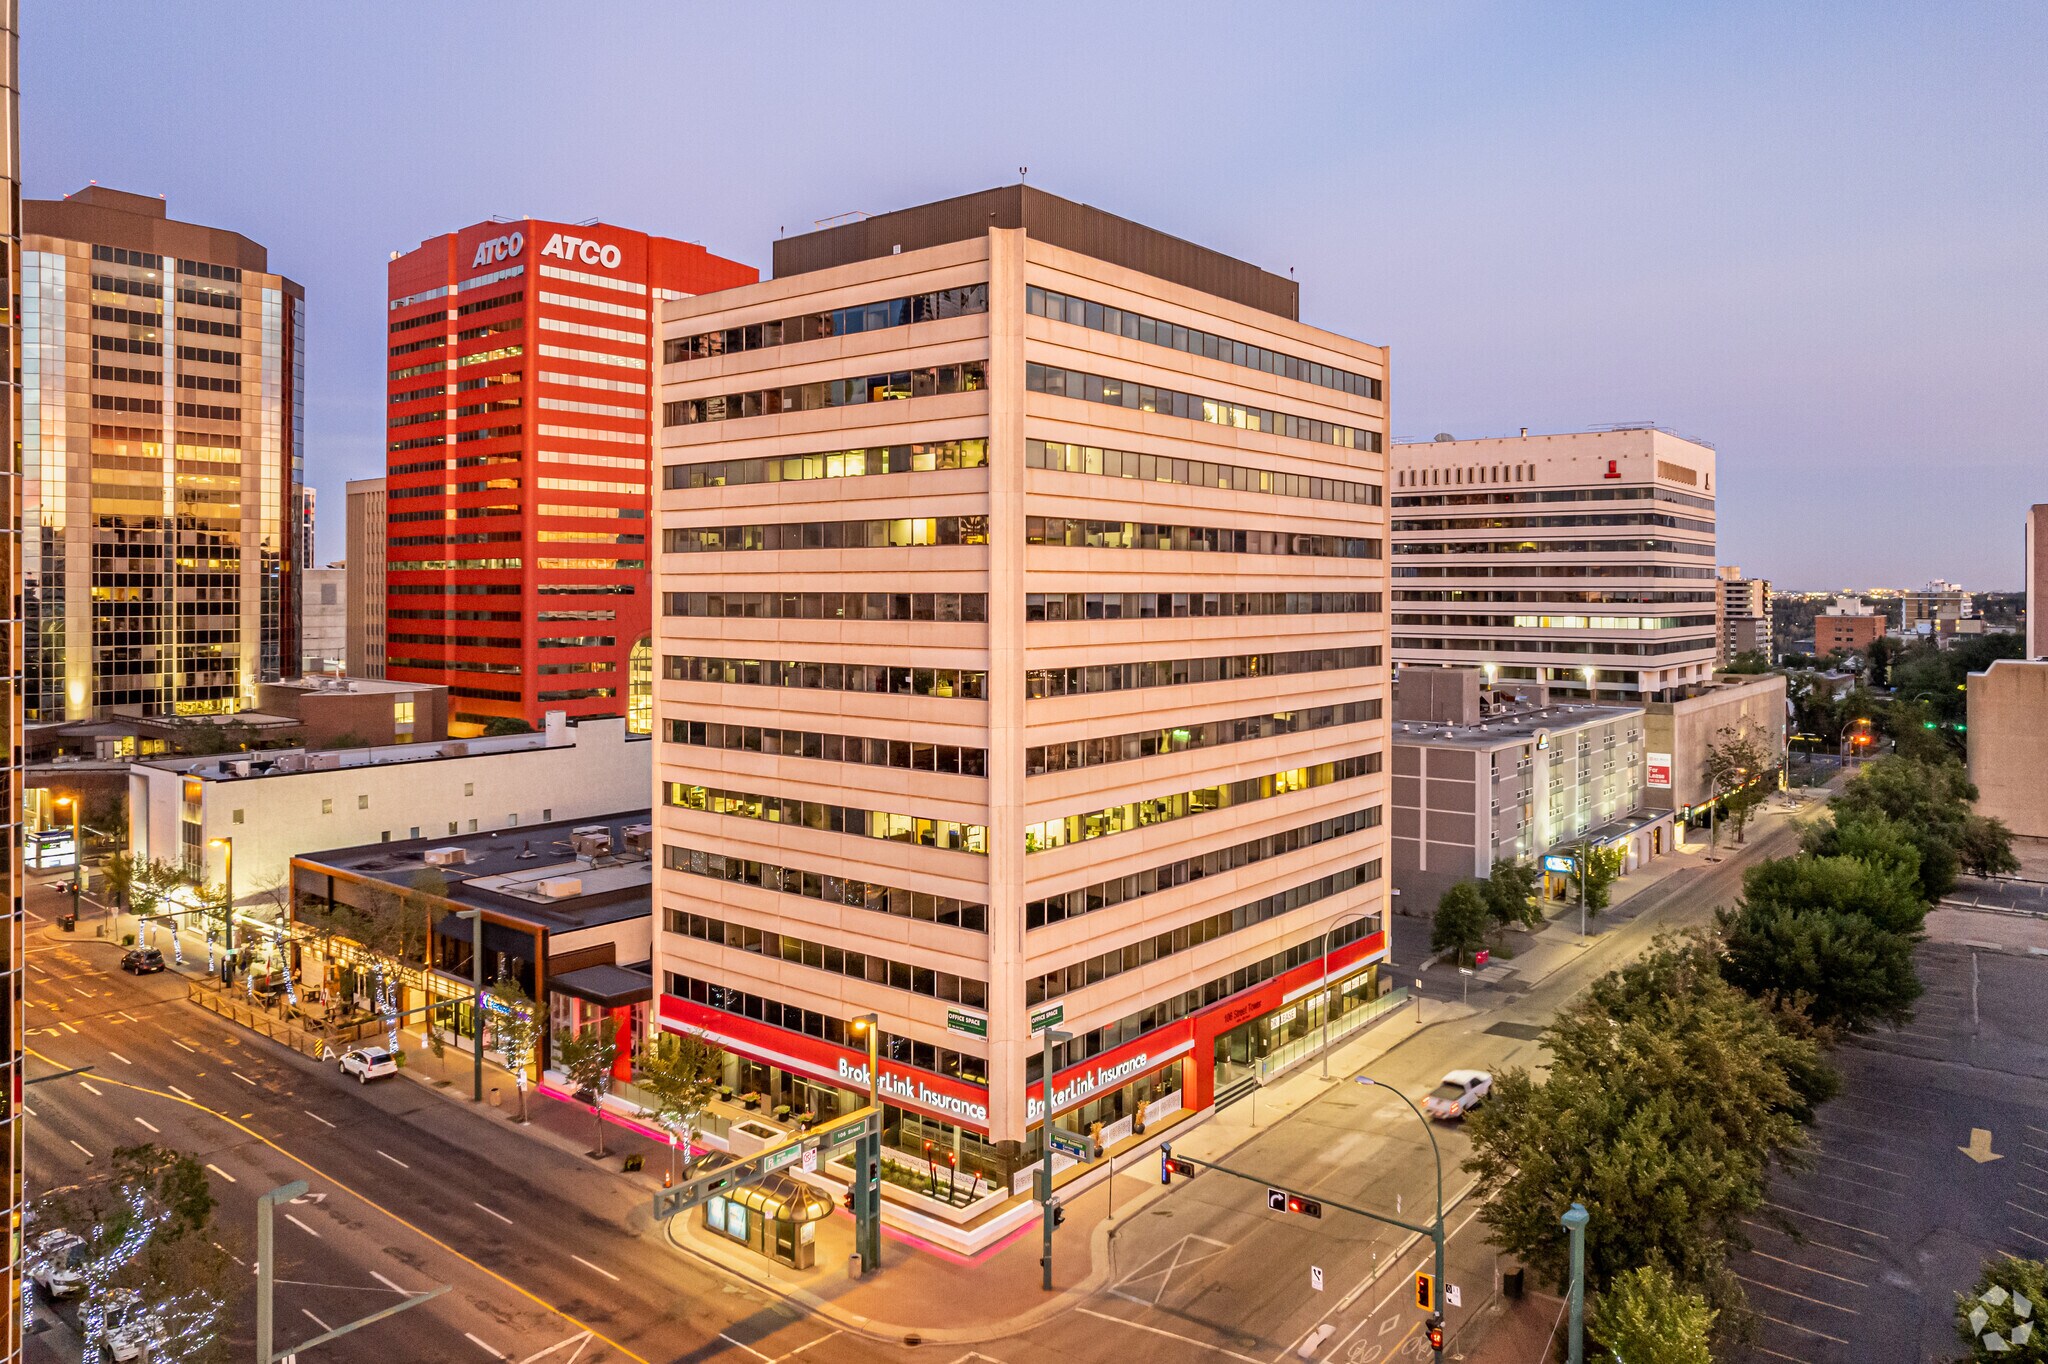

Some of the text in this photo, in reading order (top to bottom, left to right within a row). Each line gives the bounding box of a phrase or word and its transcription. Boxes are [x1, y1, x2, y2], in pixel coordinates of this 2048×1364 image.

[472, 231, 524, 269] ATCO
[540, 233, 622, 269] ATCO
[948, 1013, 980, 1026] OFFICE SPACE
[1031, 1009, 1058, 1024] OFFICE SPACE
[1234, 1005, 1247, 1019] Street
[1248, 1000, 1262, 1012] Tower
[1097, 1053, 1147, 1087] Insurance
[838, 1057, 987, 1121] BrokrLink Insurance
[847, 1125, 861, 1135] Street
